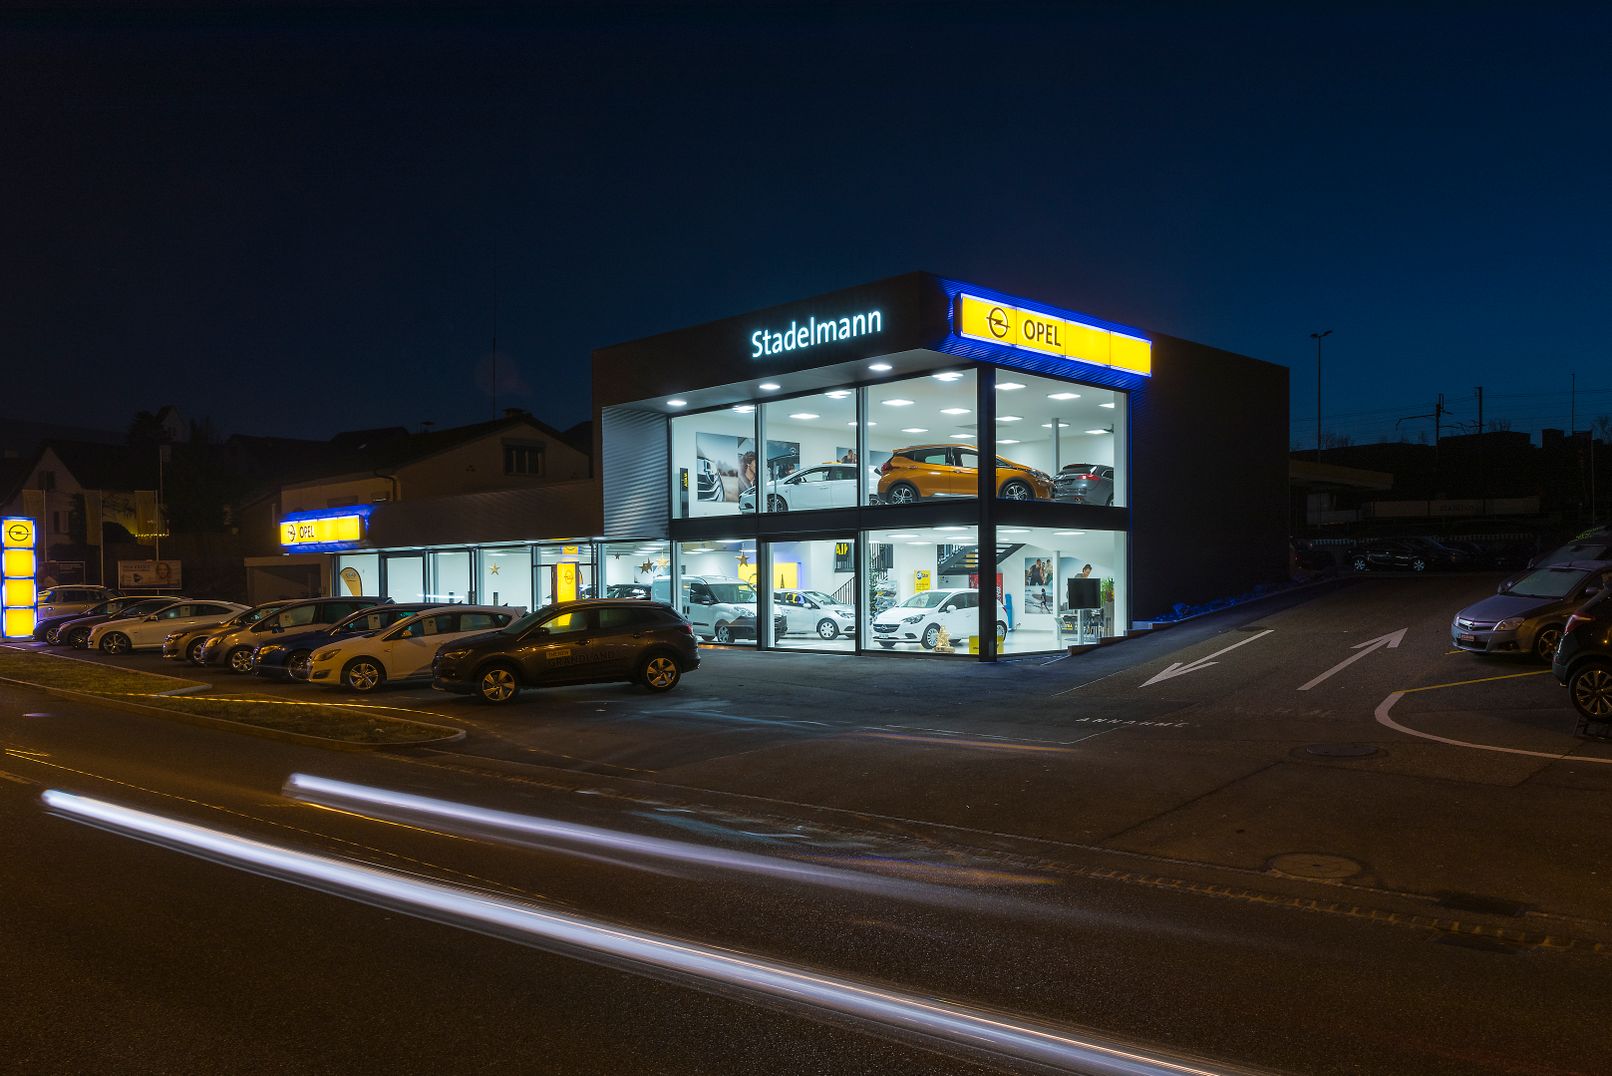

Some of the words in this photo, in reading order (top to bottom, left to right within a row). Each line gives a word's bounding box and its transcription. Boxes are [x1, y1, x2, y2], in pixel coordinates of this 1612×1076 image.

[751, 310, 881, 358] Stadelmann
[1023, 319, 1061, 347] OPEL
[299, 525, 315, 539] OPEL
